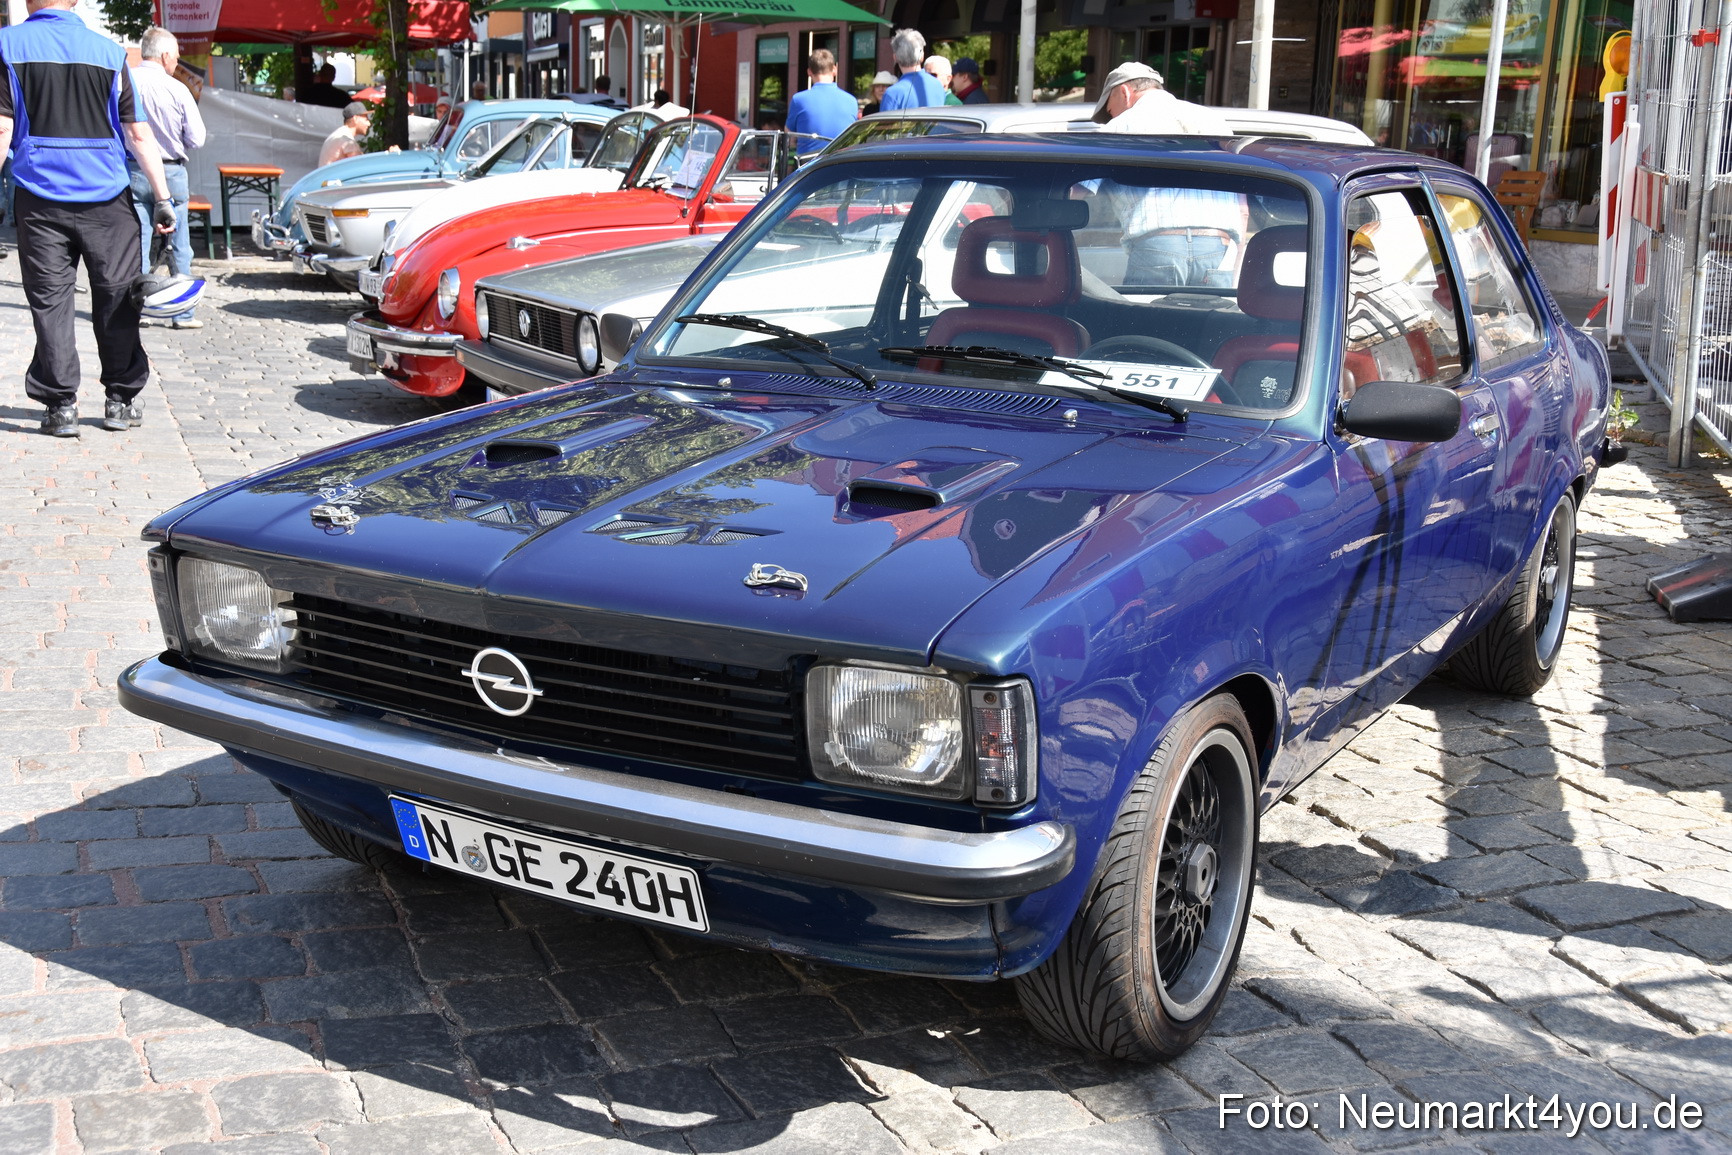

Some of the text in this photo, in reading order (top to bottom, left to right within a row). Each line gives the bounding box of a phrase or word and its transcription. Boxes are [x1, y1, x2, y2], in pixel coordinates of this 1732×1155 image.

[1121, 373, 1181, 390] 551
[408, 834, 420, 849] D
[420, 813, 459, 864] N
[483, 831, 554, 890] GE
[559, 851, 699, 923] 240H
